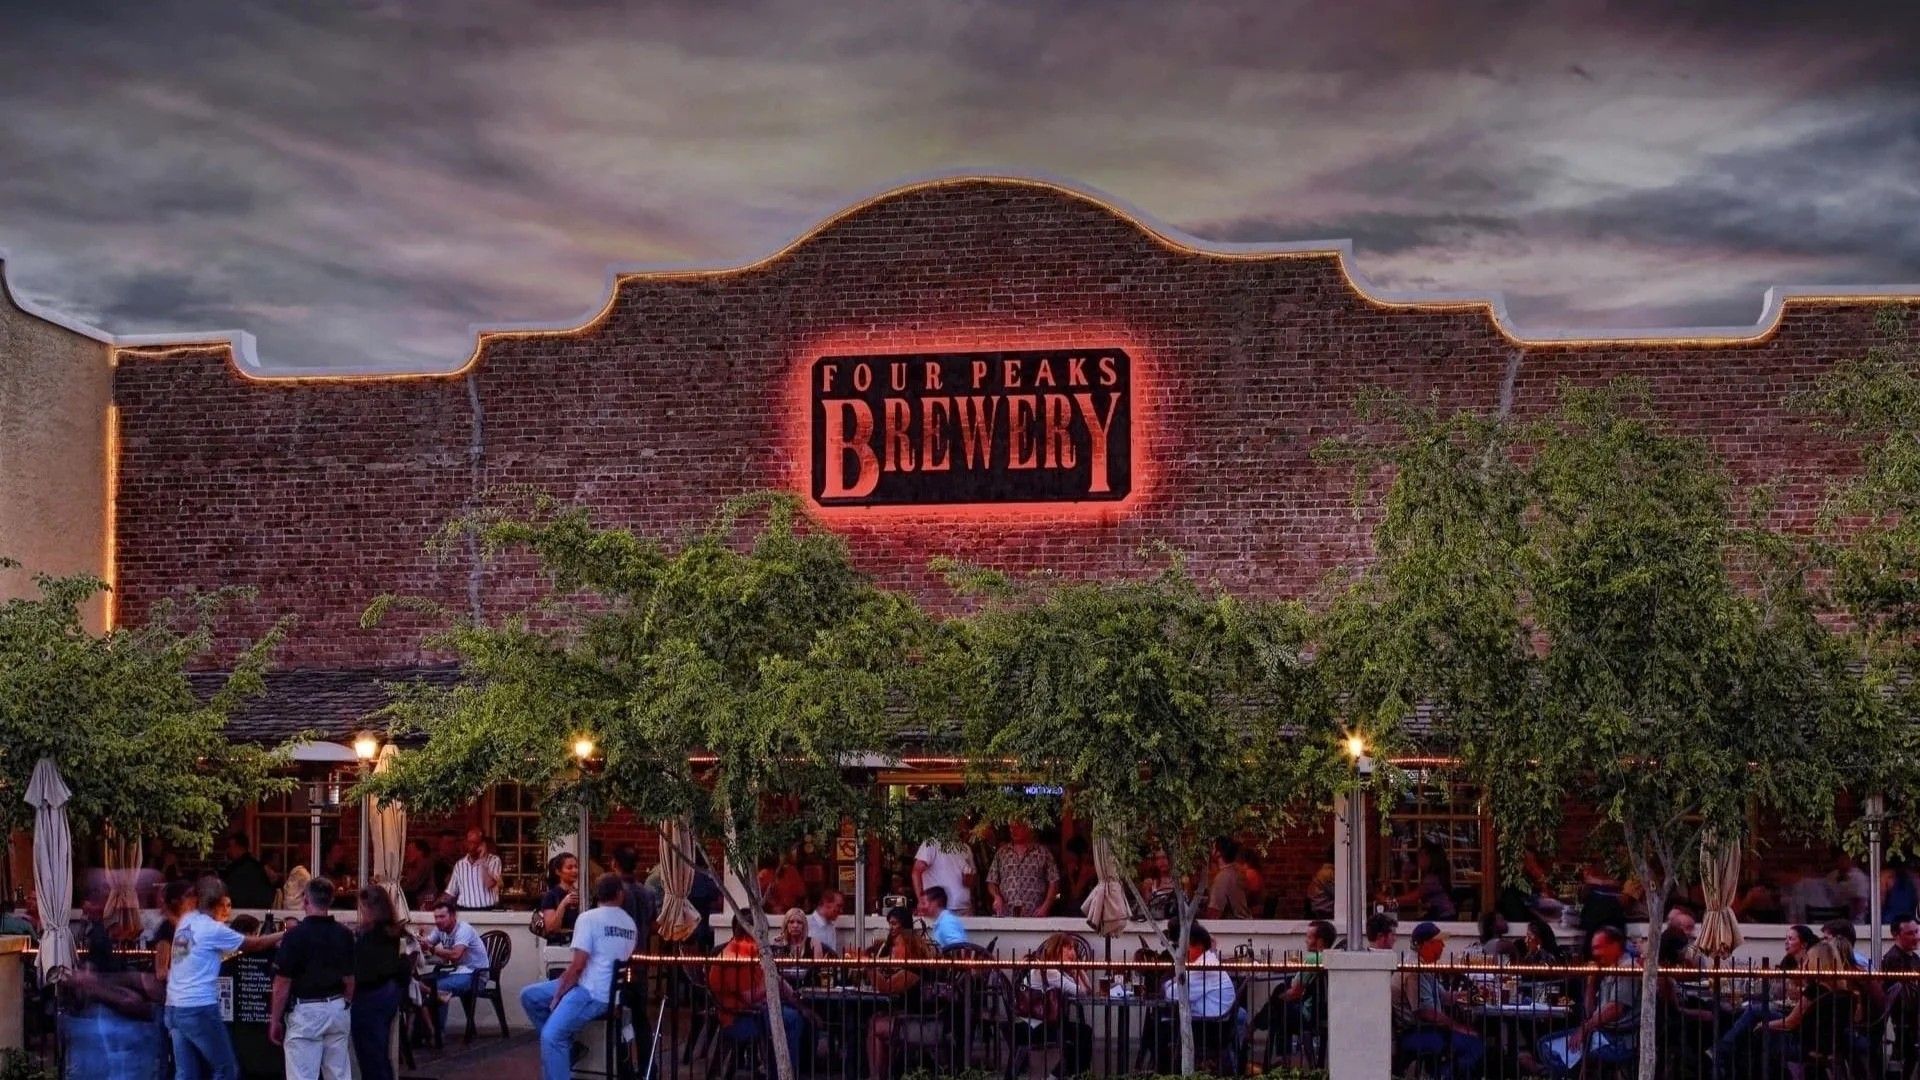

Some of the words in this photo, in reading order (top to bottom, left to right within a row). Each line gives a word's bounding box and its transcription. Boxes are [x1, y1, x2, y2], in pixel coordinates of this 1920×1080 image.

[822, 361, 943, 392] FOUR
[971, 356, 1117, 389] PEAKS
[820, 392, 1121, 498] BREWERY
